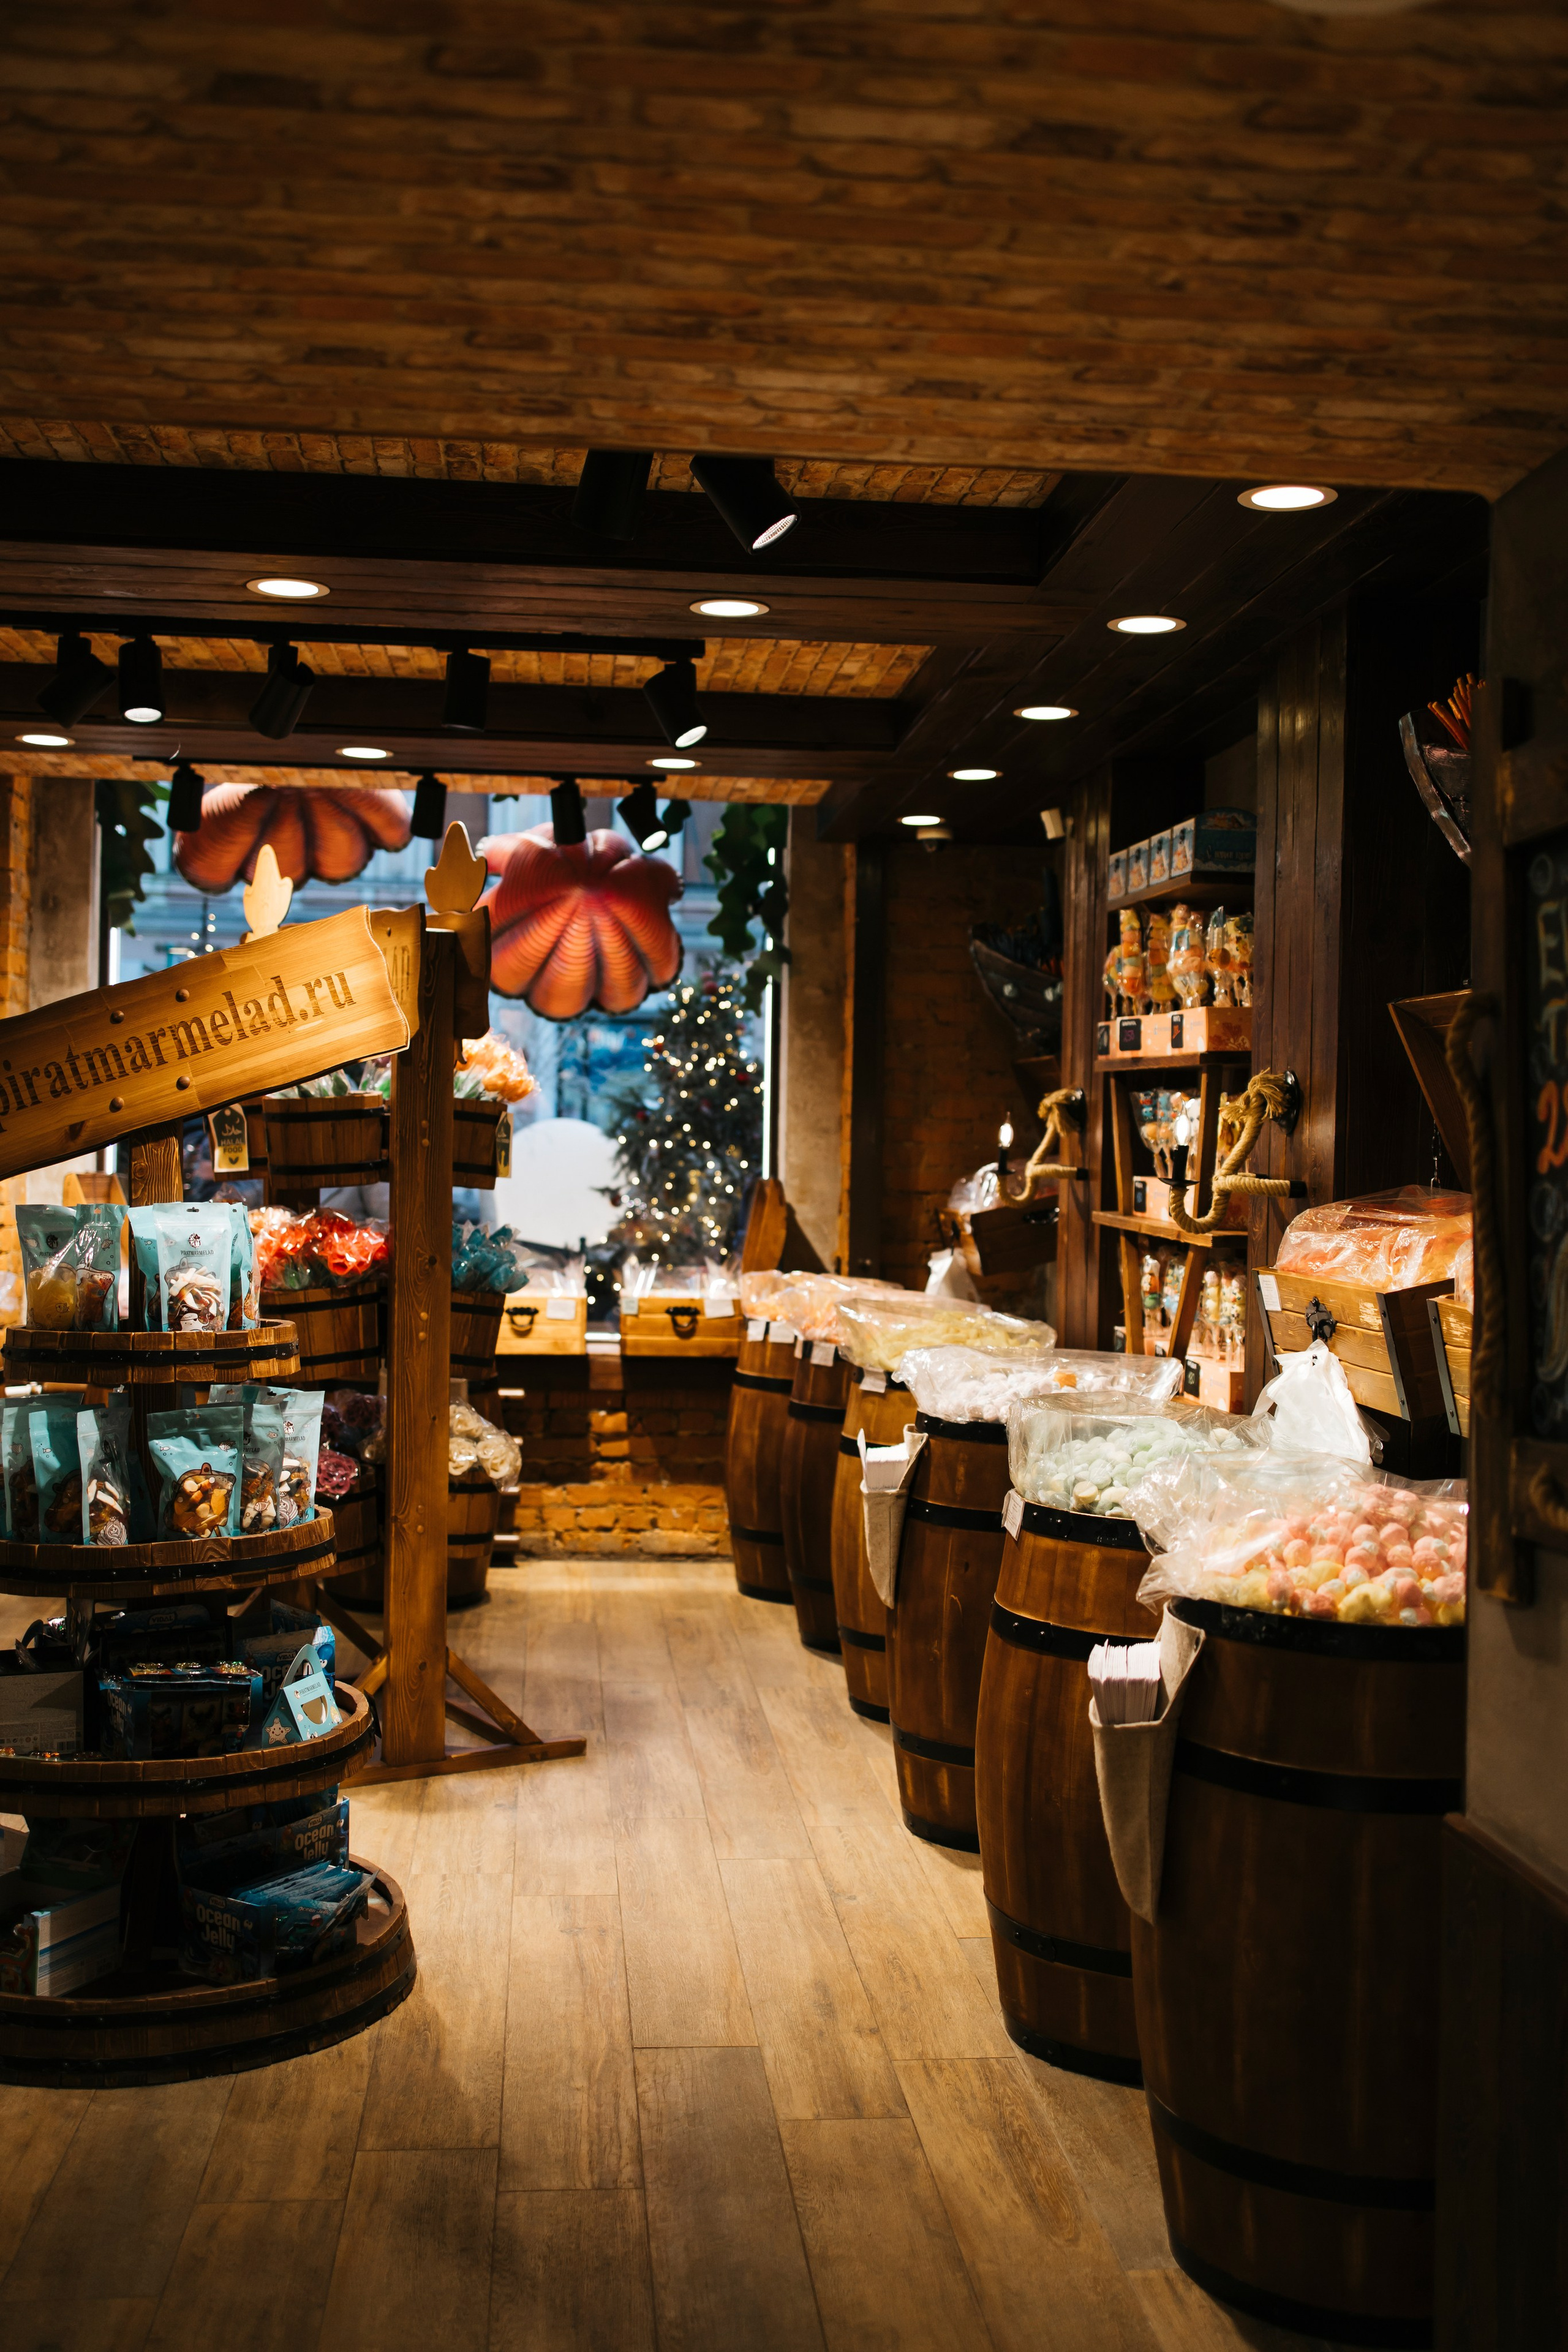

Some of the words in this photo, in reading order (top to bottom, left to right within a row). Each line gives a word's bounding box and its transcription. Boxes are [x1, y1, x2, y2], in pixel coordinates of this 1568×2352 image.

[221, 1138, 244, 1147] HALAL
[107, 1689, 127, 1716] Ocean
[295, 1824, 334, 1852] Ocean
[196, 1905, 241, 1932] Ocean
[200, 1923, 236, 1955] Jelly
